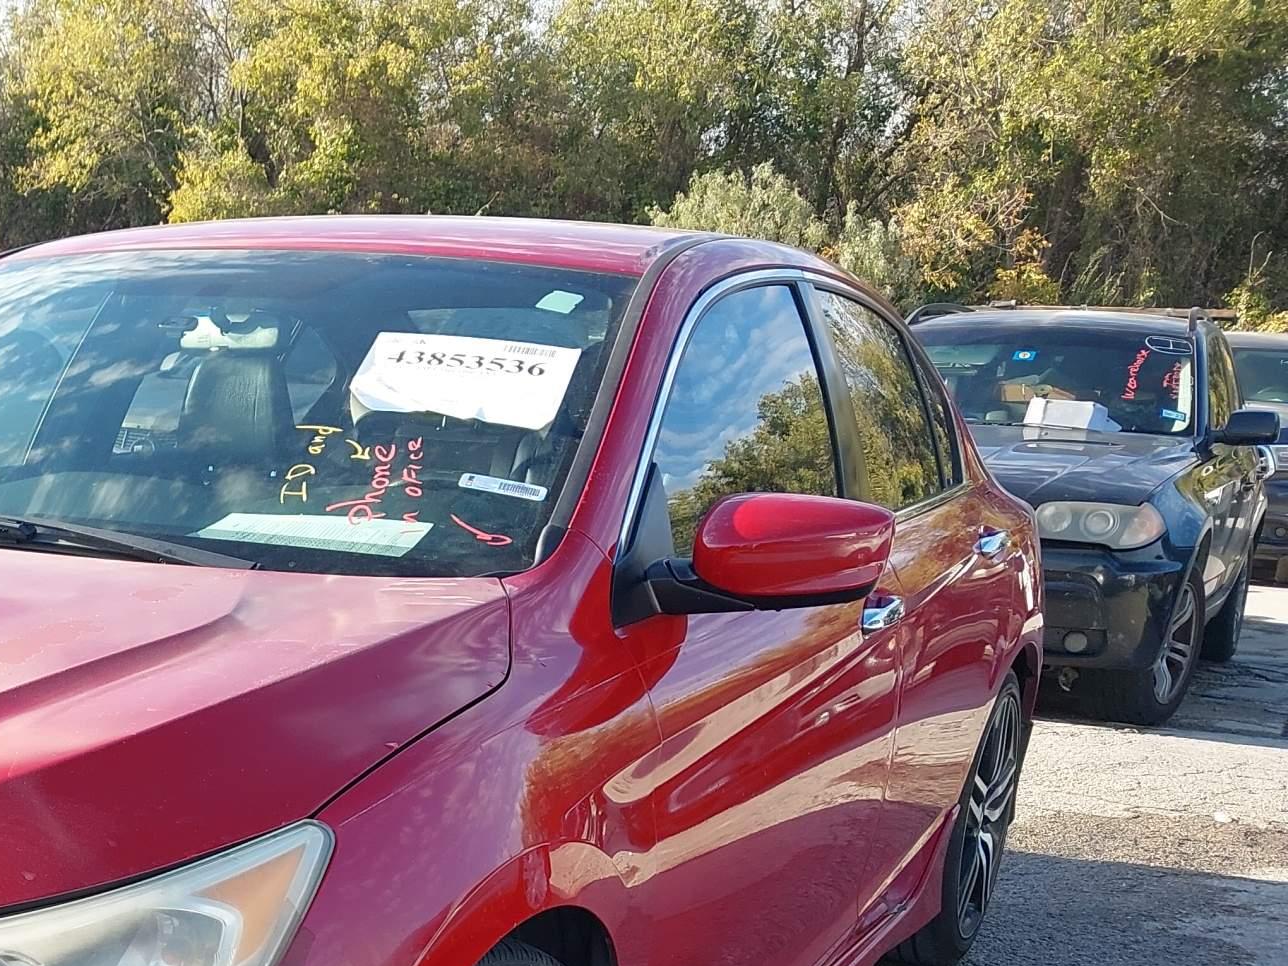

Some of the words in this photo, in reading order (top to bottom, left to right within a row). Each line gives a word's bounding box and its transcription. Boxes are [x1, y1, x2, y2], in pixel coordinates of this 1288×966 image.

[387, 349, 546, 377] 43853536
[295, 424, 345, 456] and
[279, 462, 316, 505] ID
[325, 442, 398, 526] Phone
